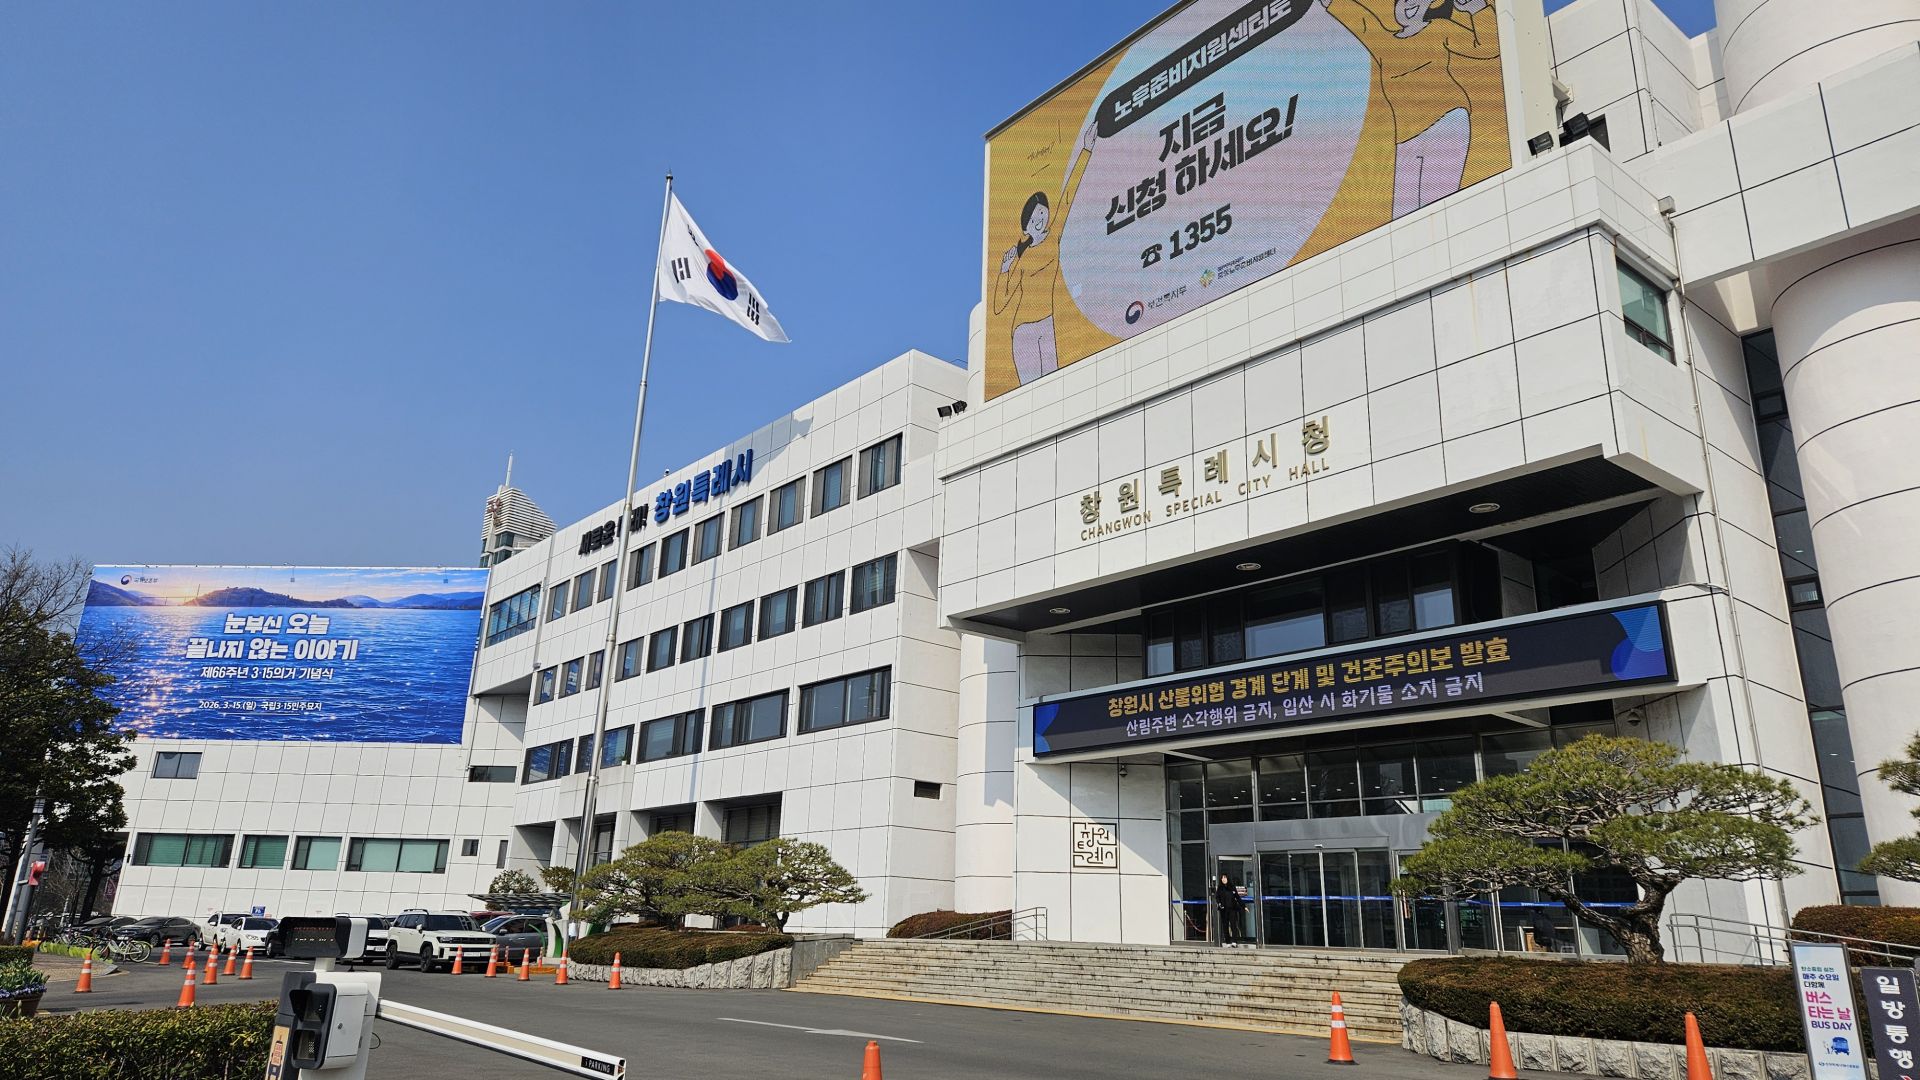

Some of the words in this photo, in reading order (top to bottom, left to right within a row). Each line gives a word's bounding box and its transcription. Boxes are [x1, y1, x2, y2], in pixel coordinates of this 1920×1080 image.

[1114, 0, 1293, 122] 노후준비지원센터로
[1158, 92, 1226, 163] 지금
[1105, 168, 1168, 236] 신청
[1175, 94, 1298, 196] 하세요!
[1169, 203, 1232, 260] 1355
[617, 503, 649, 537] 래!
[654, 449, 753, 524] 창원특례시
[1080, 510, 1152, 541] CHANGWON
[1166, 490, 1222, 517] SPECIAL
[1237, 474, 1272, 496] CITY
[1288, 457, 1330, 481] HALL
[185, 637, 244, 660] 끝나지
[248, 638, 288, 660] 않는
[294, 639, 359, 660] 이야기
[223, 613, 283, 634] 눈부신
[286, 613, 330, 635] 오늘
[200, 666, 249, 679] 제66주년
[298, 667, 334, 680] 기념식
[1108, 692, 1154, 718] 창원시
[1158, 681, 1225, 709] 산불위험
[1230, 674, 1266, 700] 경계
[1271, 667, 1310, 694] 단계
[1316, 663, 1336, 688] 및
[1341, 646, 1453, 684] 건조주의보
[1460, 636, 1511, 667] 발효
[1126, 713, 1177, 738] 산림주변
[1182, 705, 1237, 729] 소각행위
[1243, 700, 1277, 722] 금지,
[1283, 695, 1314, 717] 입산
[1320, 691, 1335, 711] 시
[1341, 684, 1393, 709] 화기물
[1401, 677, 1438, 701] 소지
[1444, 671, 1483, 697] 금지
[1805, 991, 1832, 1004] 버스
[1818, 973, 1839, 981] 수요일
[1808, 1006, 1834, 1019] 타는
[1837, 1007, 1851, 1020] 날
[1811, 1020, 1831, 1029] BUS
[1832, 1021, 1852, 1031] DAY
[1876, 975, 1914, 1070] 일방통행
[588, 1060, 611, 1074] PARKING
